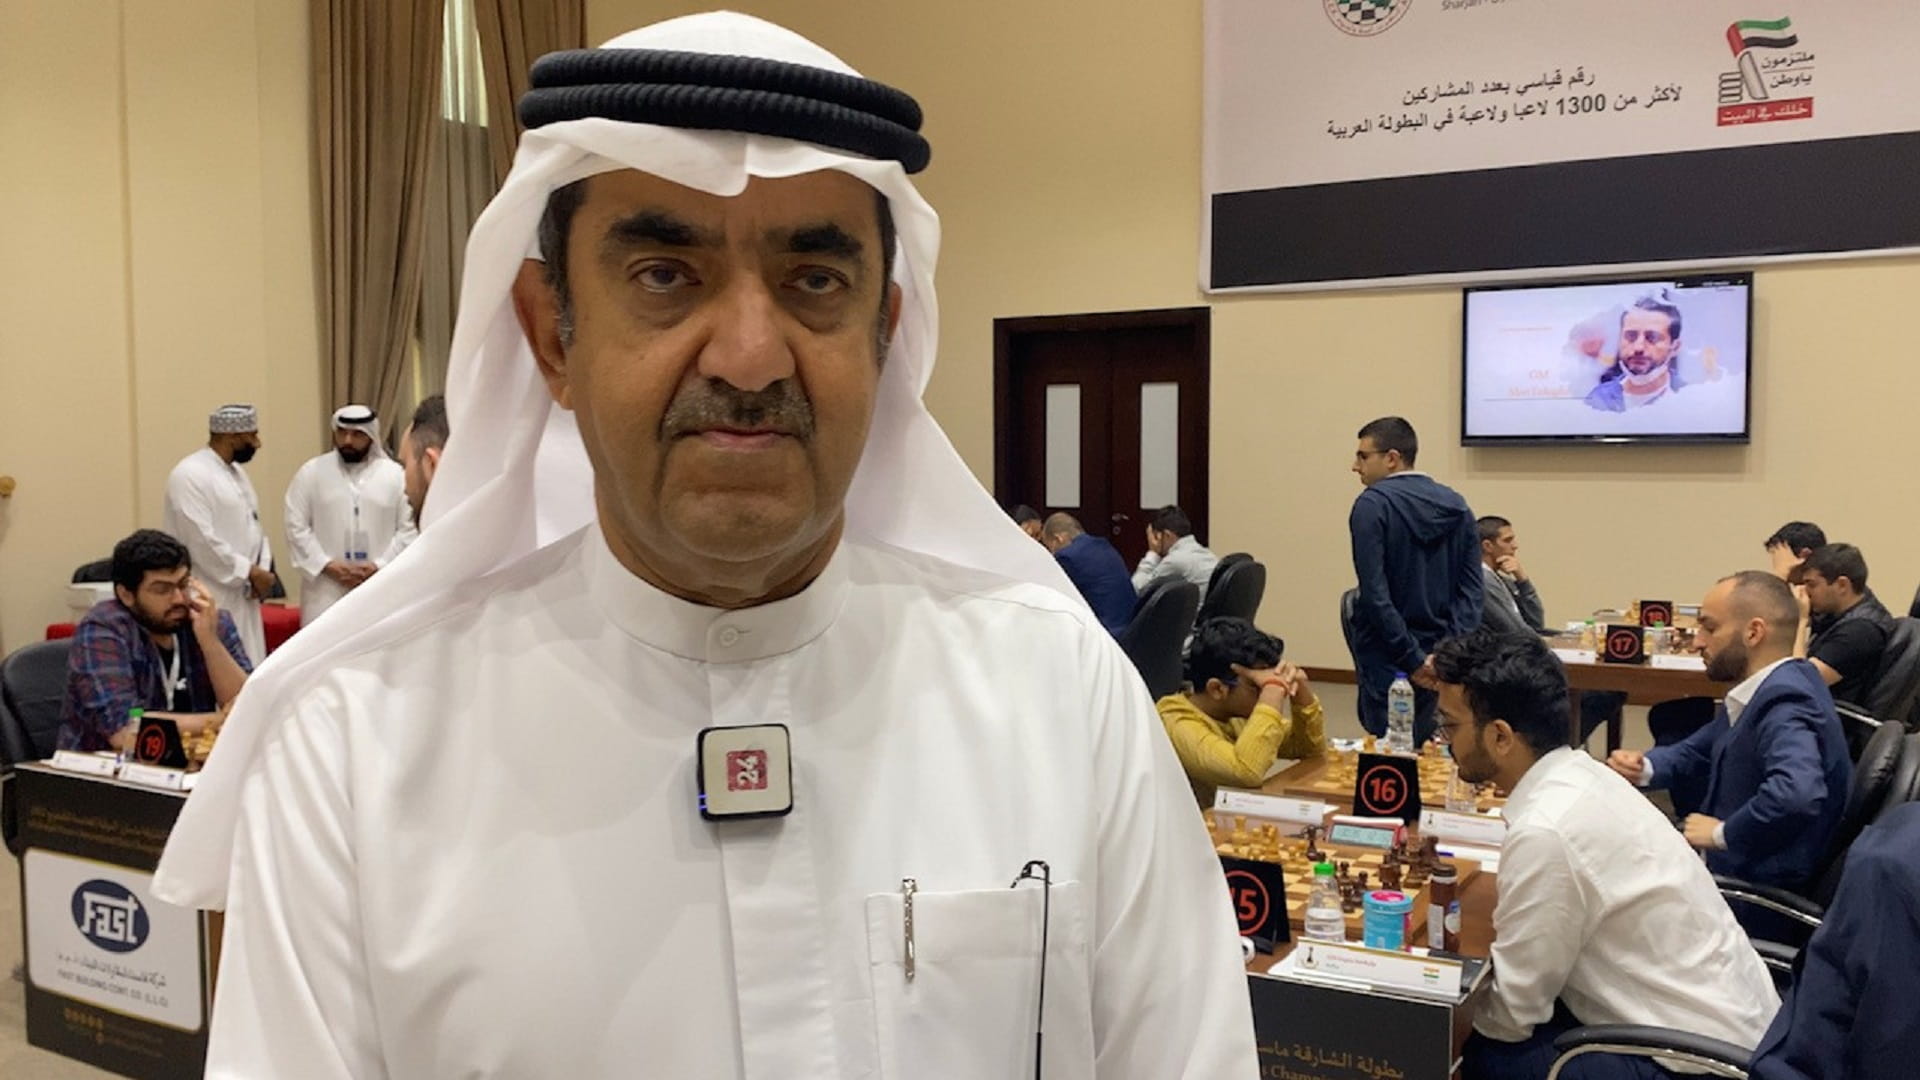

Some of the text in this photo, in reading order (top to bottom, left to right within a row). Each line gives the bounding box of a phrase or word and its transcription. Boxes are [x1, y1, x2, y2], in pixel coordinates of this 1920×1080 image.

[1402, 66, 1595, 105] رقم قياسي بعدد المشاركين
[1327, 83, 1682, 139] لأكثر من 1300 لاعبا ولاعبة في البطولة العربية
[1615, 637, 1633, 652] 17
[146, 736, 162, 757] 19
[1370, 778, 1396, 802] 16
[1230, 888, 1257, 919] 5
[1293, 1043, 1352, 1068] الشارقة
[1357, 1055, 1404, 1079] بطولة
